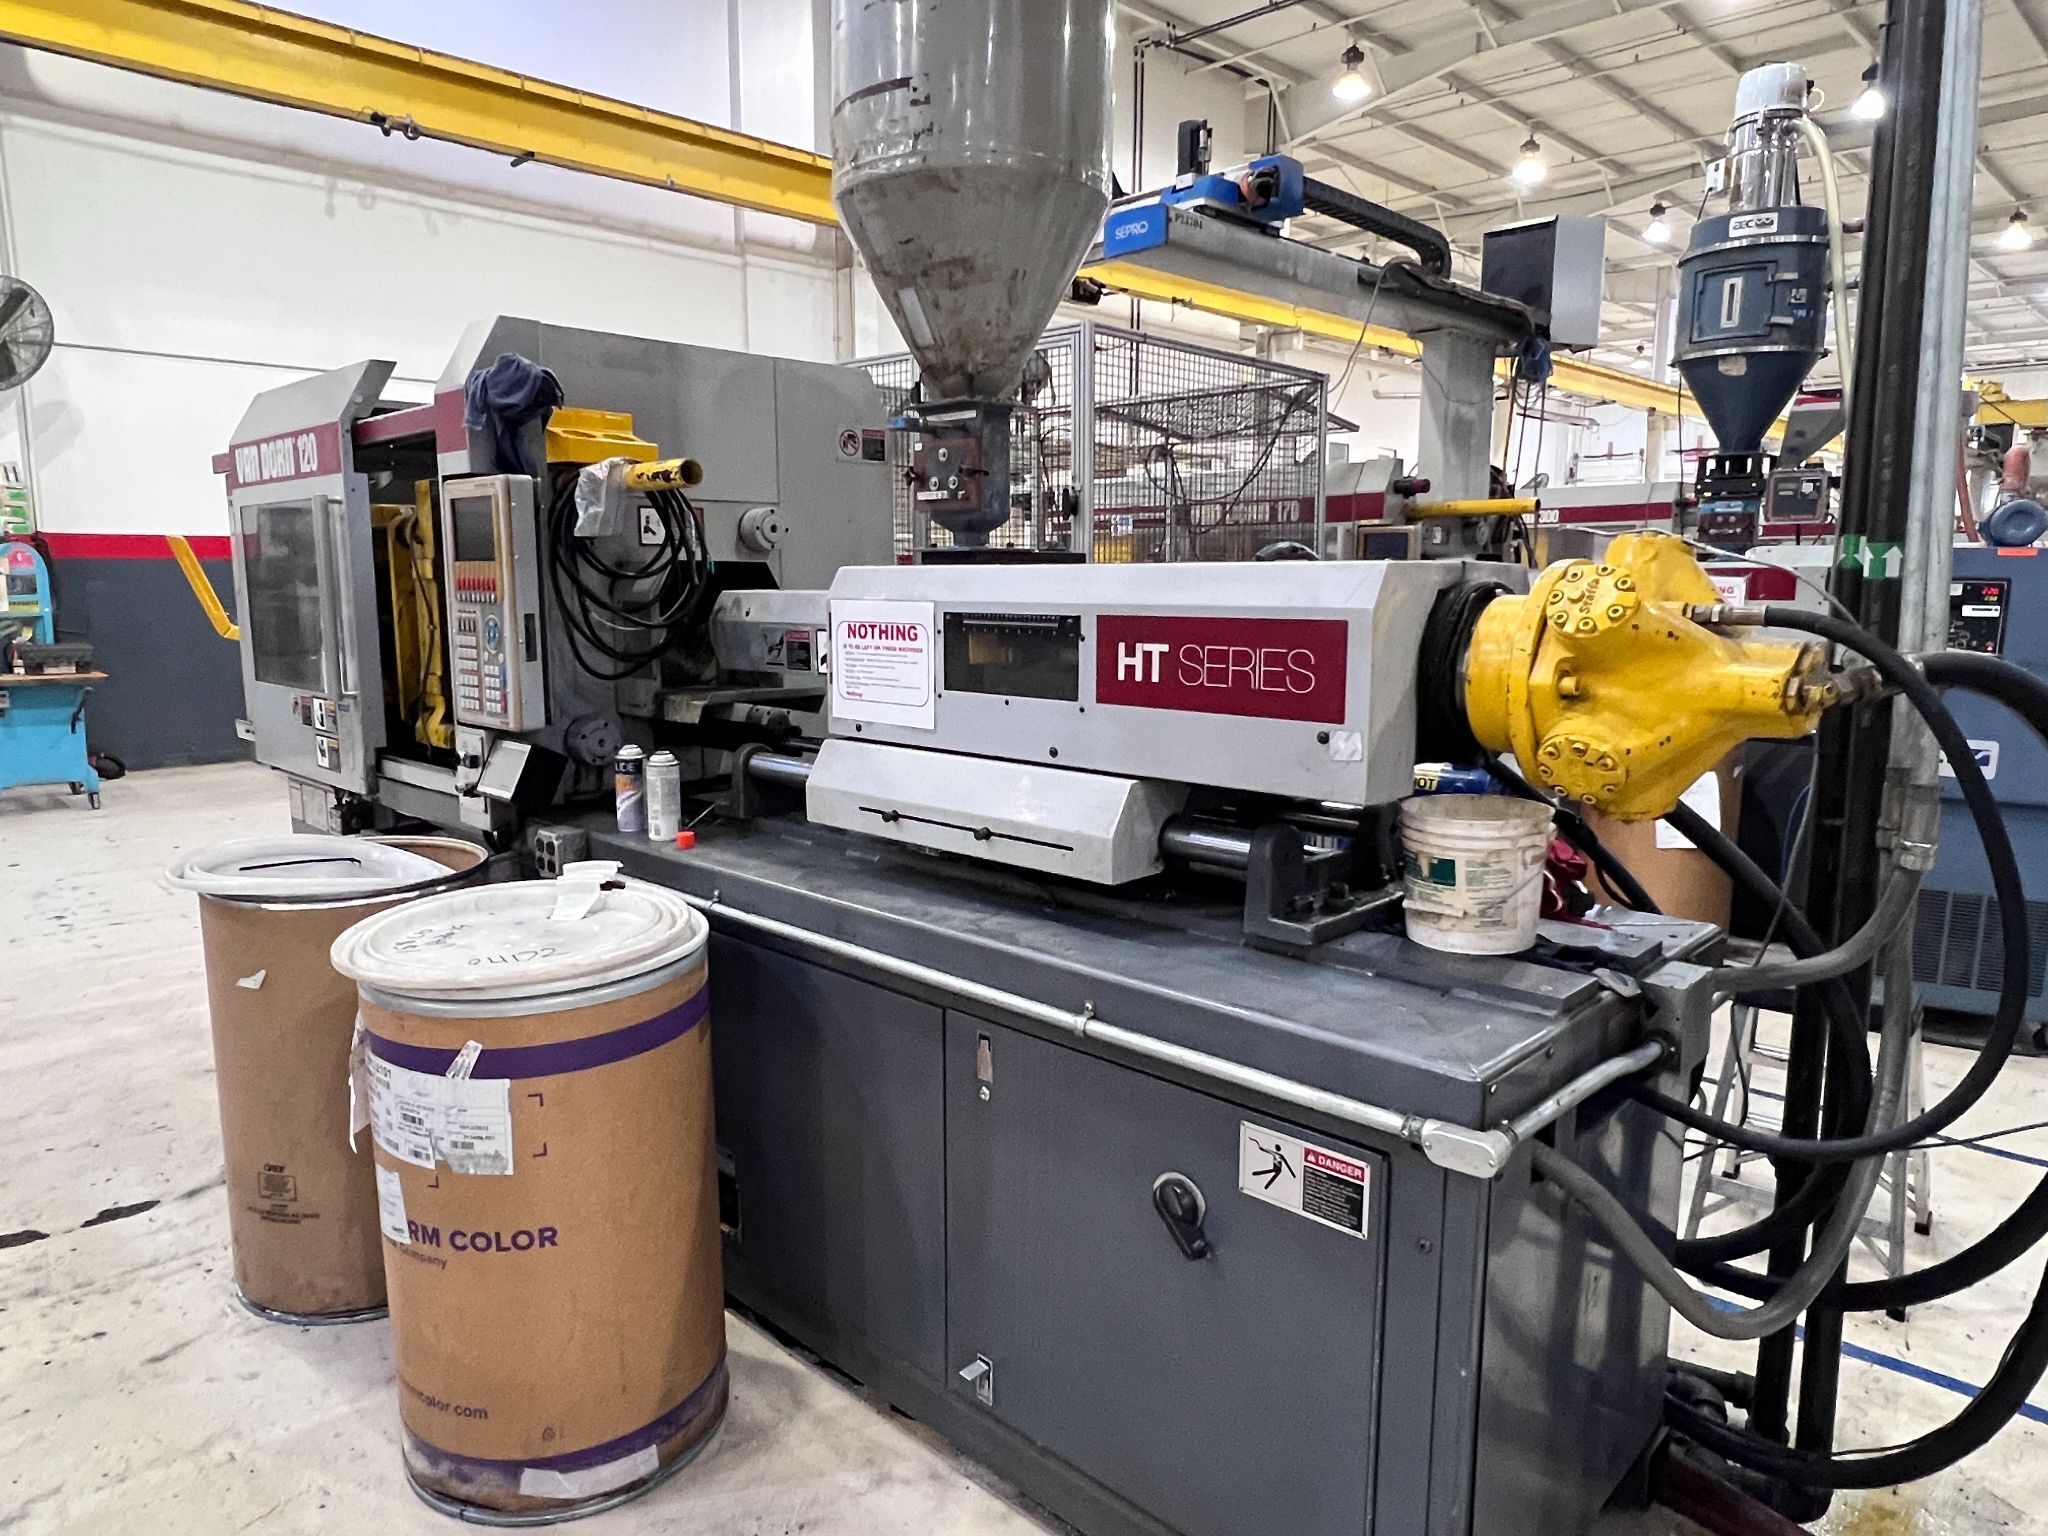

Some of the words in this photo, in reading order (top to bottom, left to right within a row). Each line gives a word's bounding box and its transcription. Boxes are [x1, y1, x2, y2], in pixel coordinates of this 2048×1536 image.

[1114, 220, 1149, 240] SEPRO
[235, 445, 260, 484] VAN
[260, 437, 295, 480] DORN
[296, 432, 318, 473] 120
[847, 623, 918, 642] NOTHING
[1117, 641, 1169, 683] HT
[1178, 644, 1315, 694] SERIES
[1318, 1155, 1362, 1179] DANGER
[407, 1219, 441, 1248] RM
[448, 1226, 558, 1253] COLOR
